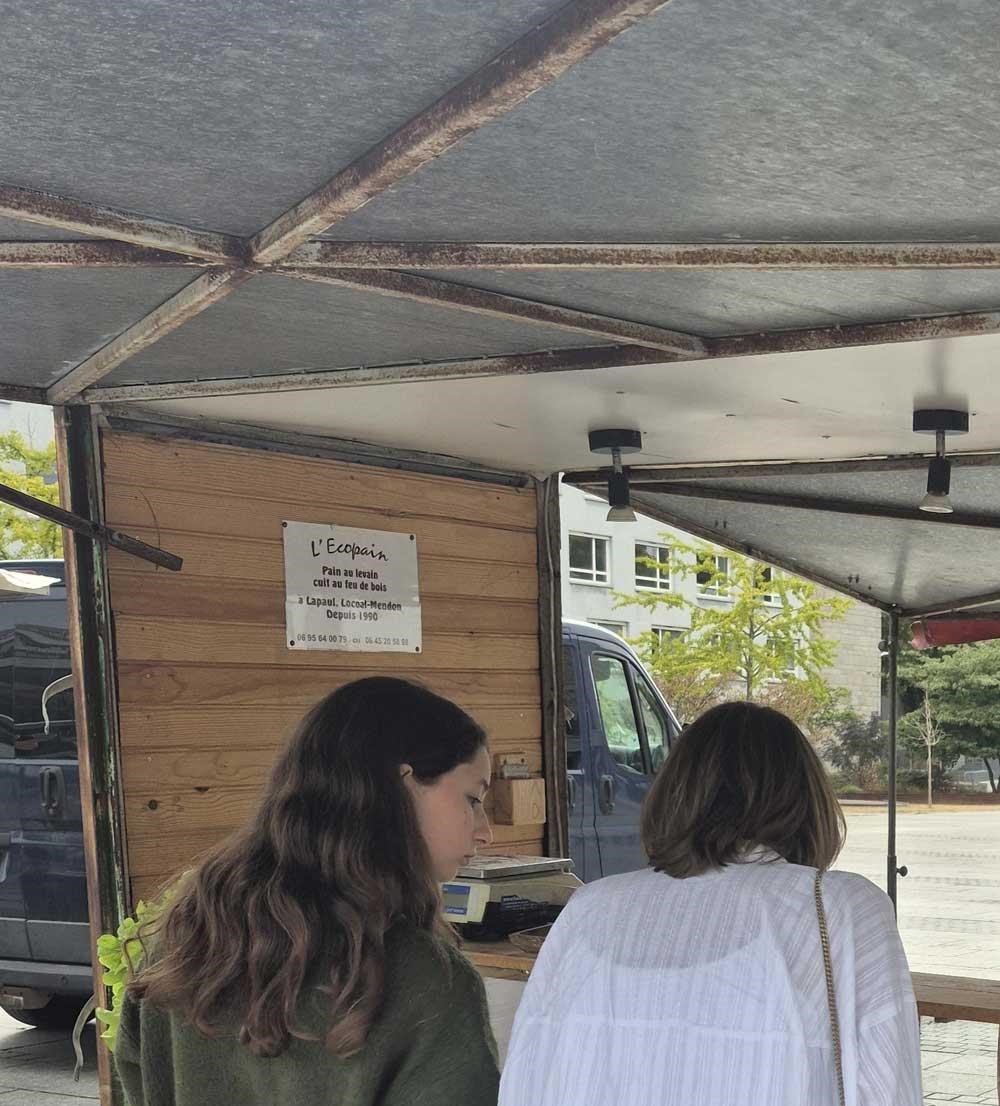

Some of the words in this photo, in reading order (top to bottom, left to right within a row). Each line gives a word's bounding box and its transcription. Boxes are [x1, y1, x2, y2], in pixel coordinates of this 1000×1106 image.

[322, 566, 341, 576] Pain
[344, 570, 353, 578] au
[356, 569, 378, 579] levain
[313, 578, 330, 588] cuit
[332, 580, 342, 588] au
[345, 580, 357, 589] feu
[360, 582, 369, 590] de
[371, 582, 387, 592] bois
[326, 610, 356, 621] Depuis
[360, 612, 378, 621] 1990
[297, 634, 306, 642] 06
